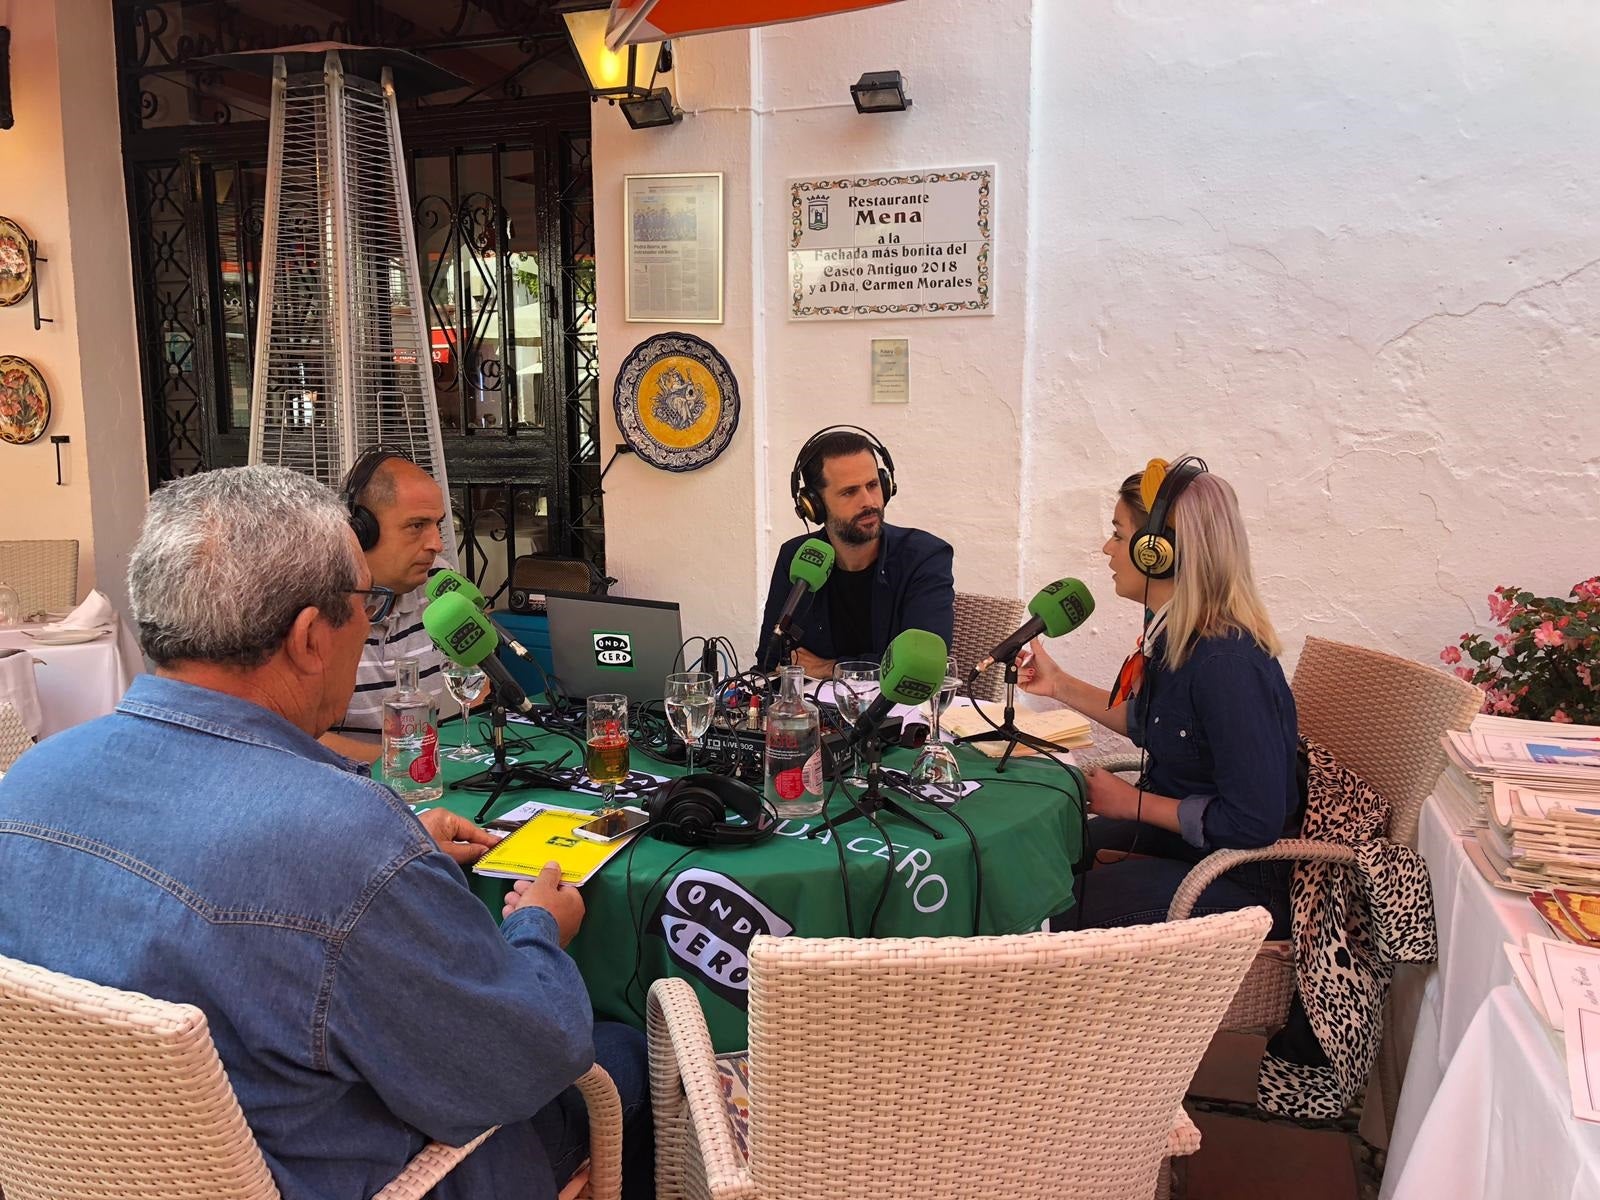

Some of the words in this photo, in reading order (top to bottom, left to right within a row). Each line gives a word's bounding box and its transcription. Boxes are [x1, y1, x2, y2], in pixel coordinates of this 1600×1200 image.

[848, 194, 930, 208] Restaurante
[855, 210, 922, 226] Mena
[877, 235, 885, 245] a
[888, 232, 901, 244] la
[815, 247, 868, 261] Fachada
[871, 246, 899, 259] más
[902, 243, 943, 258] bonita
[946, 242, 967, 256] del
[823, 265, 864, 277] Casco
[867, 262, 918, 277] Antiguo
[921, 260, 958, 274] 2018
[809, 284, 817, 295] y
[819, 283, 827, 293] a
[862, 278, 914, 291] Carmen
[917, 276, 973, 289] Morales
[598, 639, 626, 648] ONDA
[602, 652, 627, 662] CERO
[741, 743, 754, 751] 902
[846, 837, 949, 913] CERO
[688, 885, 762, 935] OND
[670, 923, 749, 984] CERO
